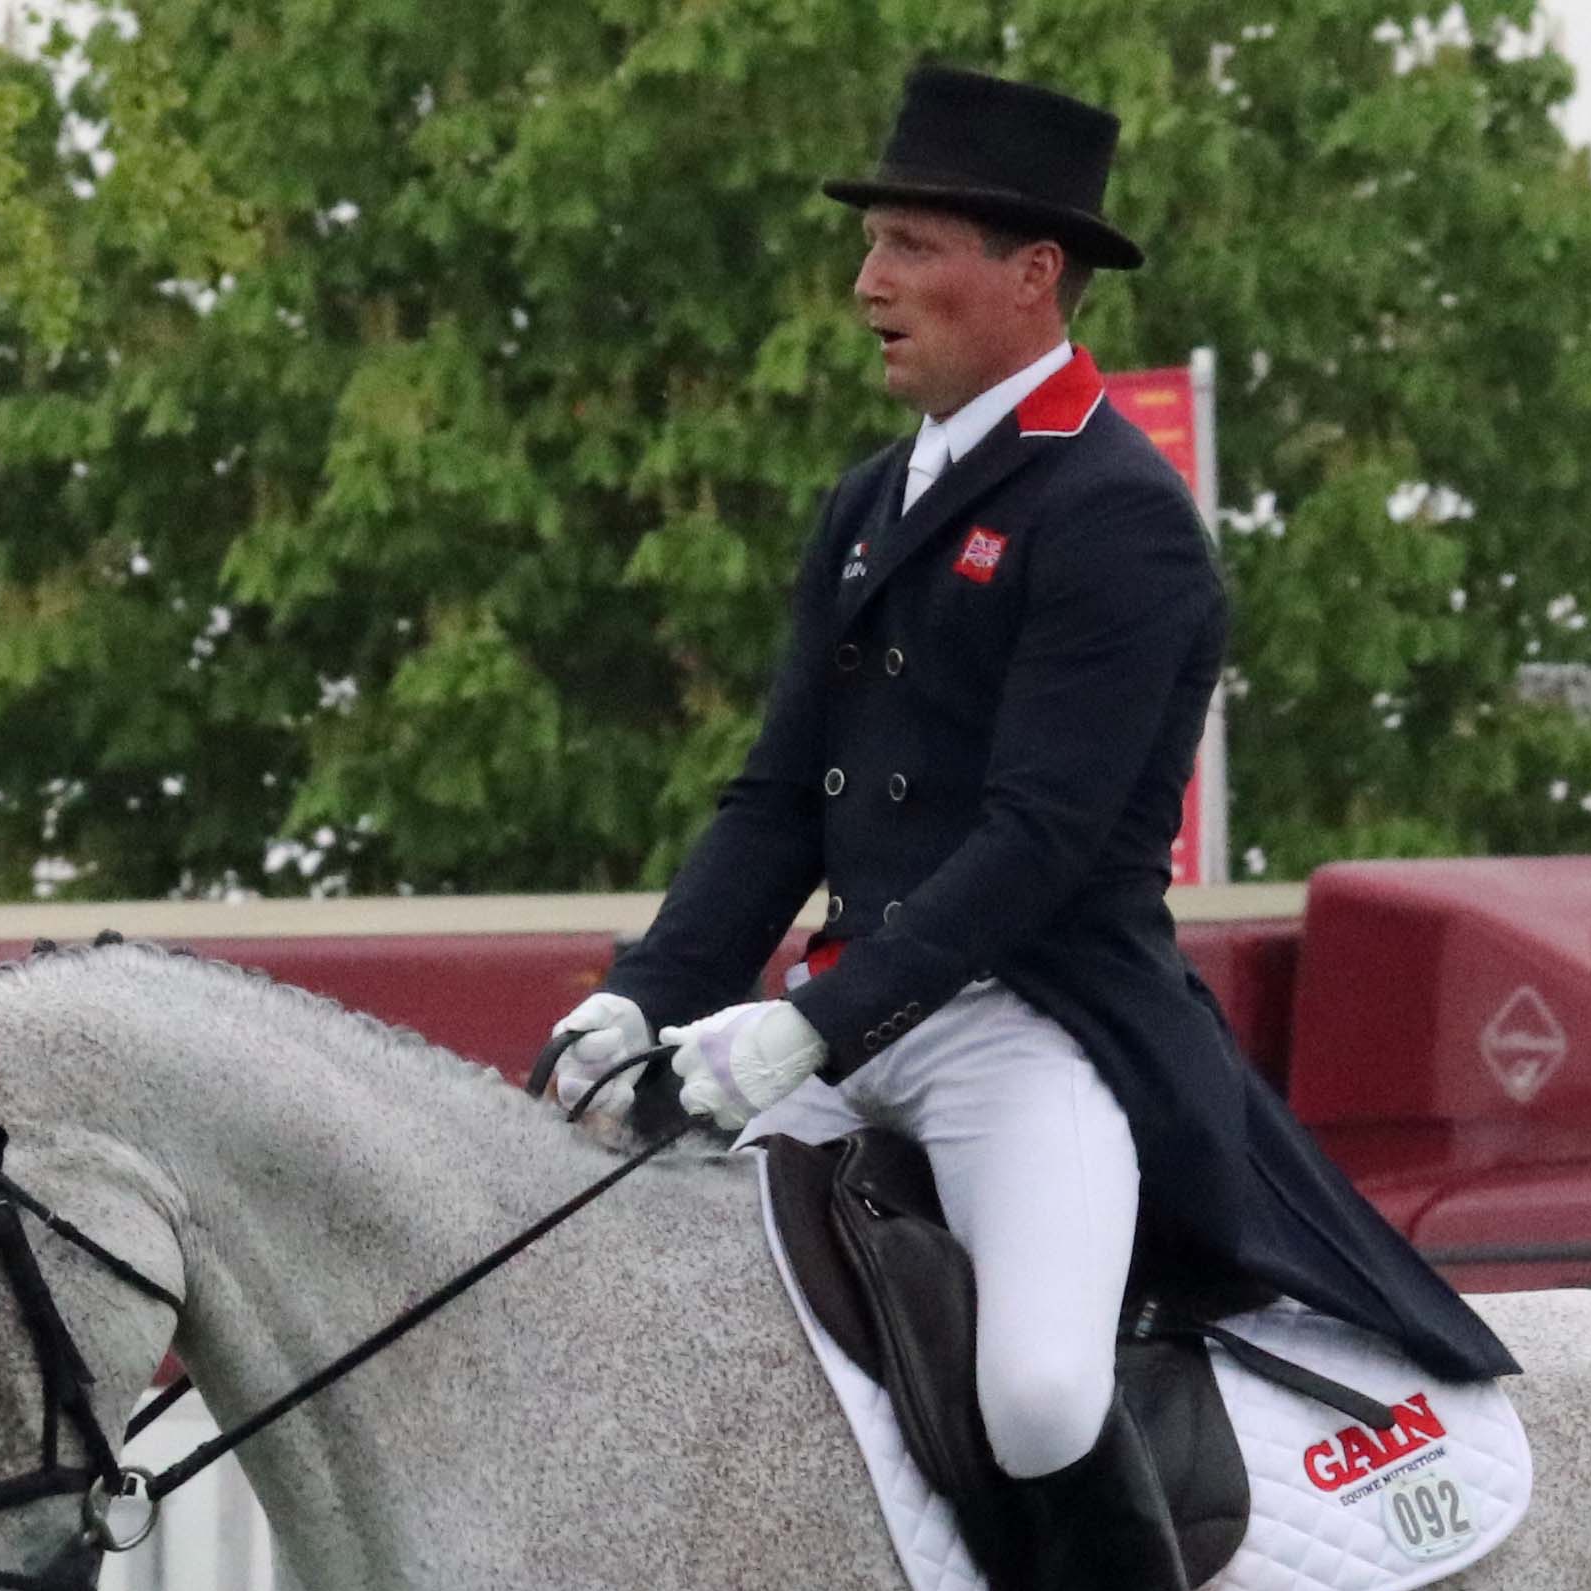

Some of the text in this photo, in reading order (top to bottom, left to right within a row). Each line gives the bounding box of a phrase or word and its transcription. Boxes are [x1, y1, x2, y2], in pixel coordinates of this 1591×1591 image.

[1302, 1391, 1448, 1492] GAIN
[1340, 1447, 1447, 1507] EQUINE NUTRITION
[1393, 1479, 1472, 1548] 092
